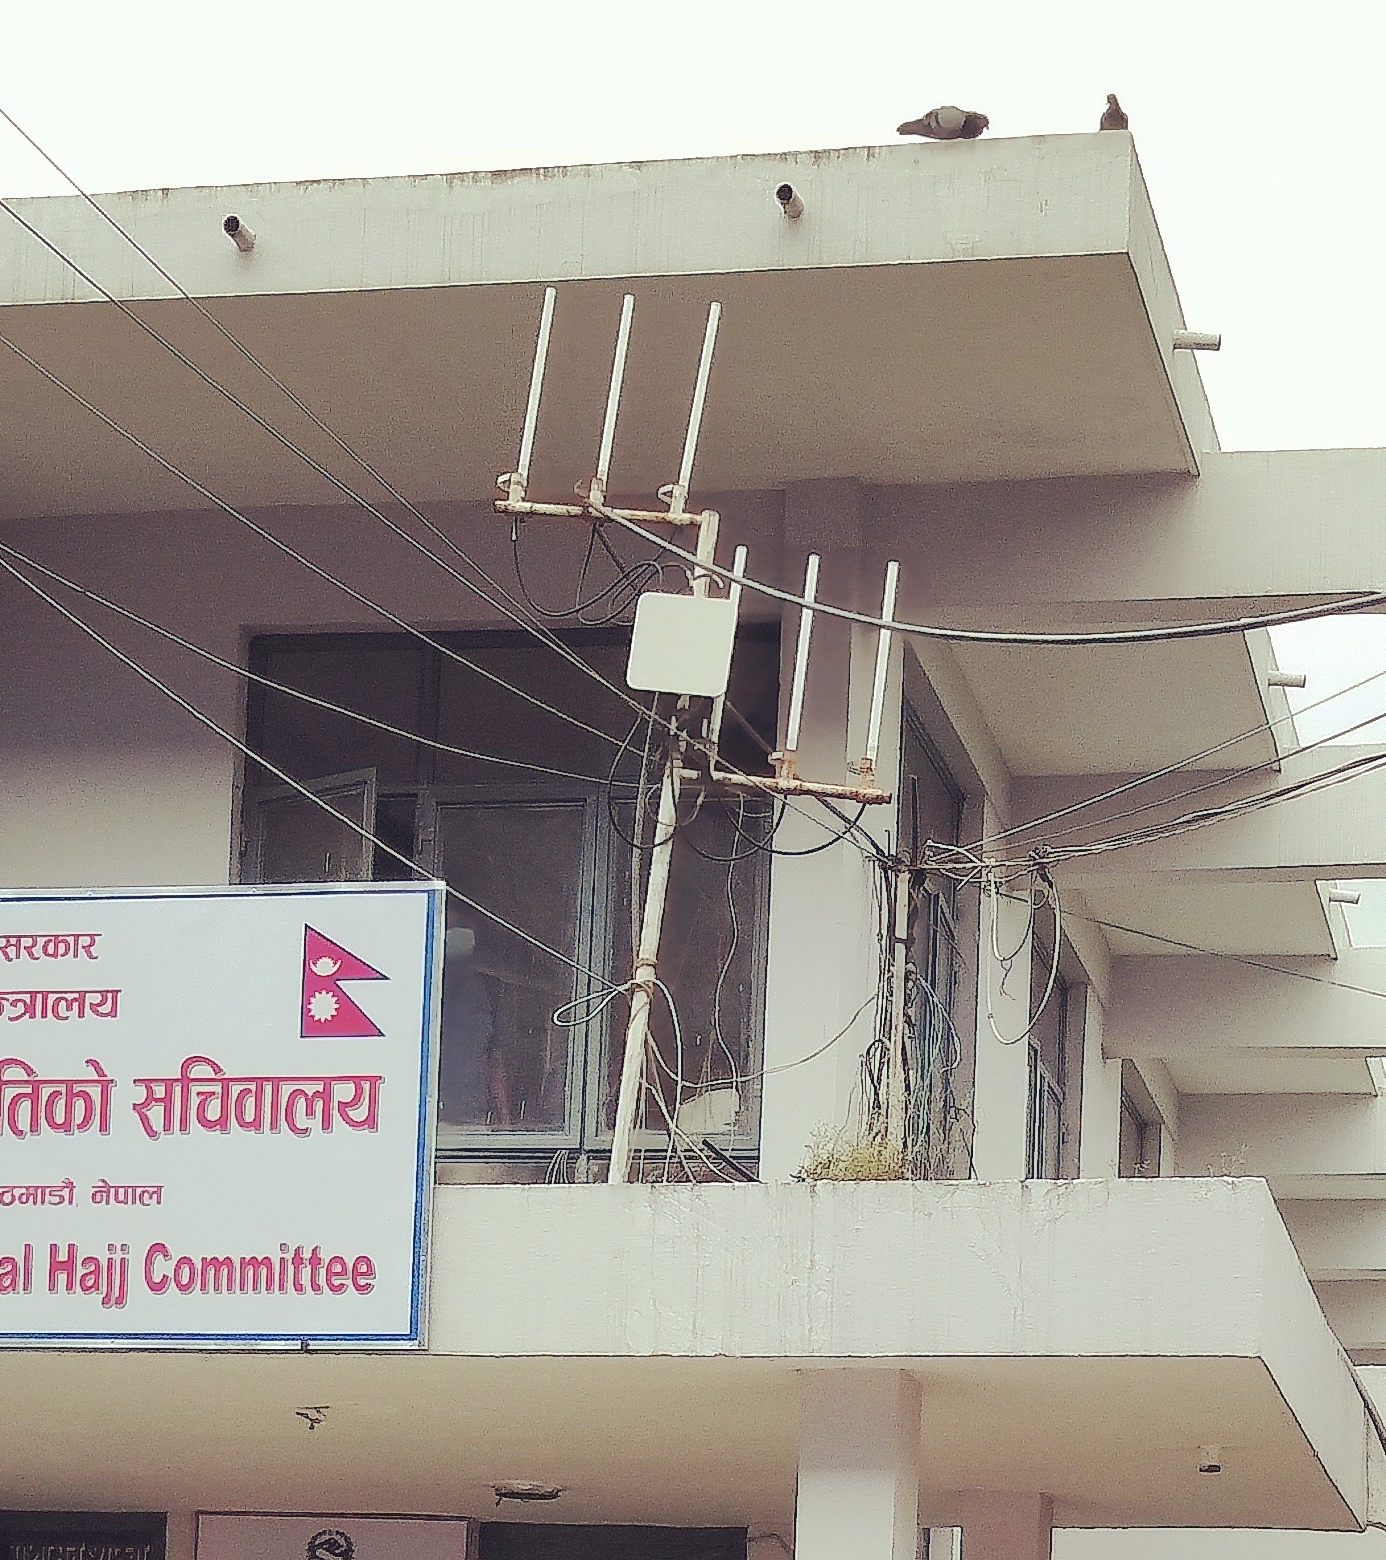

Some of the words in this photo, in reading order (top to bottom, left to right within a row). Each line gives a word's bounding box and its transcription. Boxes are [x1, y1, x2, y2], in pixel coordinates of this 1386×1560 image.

[132, 1056, 385, 1141] सचिवालय
[91, 1179, 165, 1206] नेपाल
[48, 1244, 129, 1309] Hajj
[145, 1243, 376, 1295] Committee
